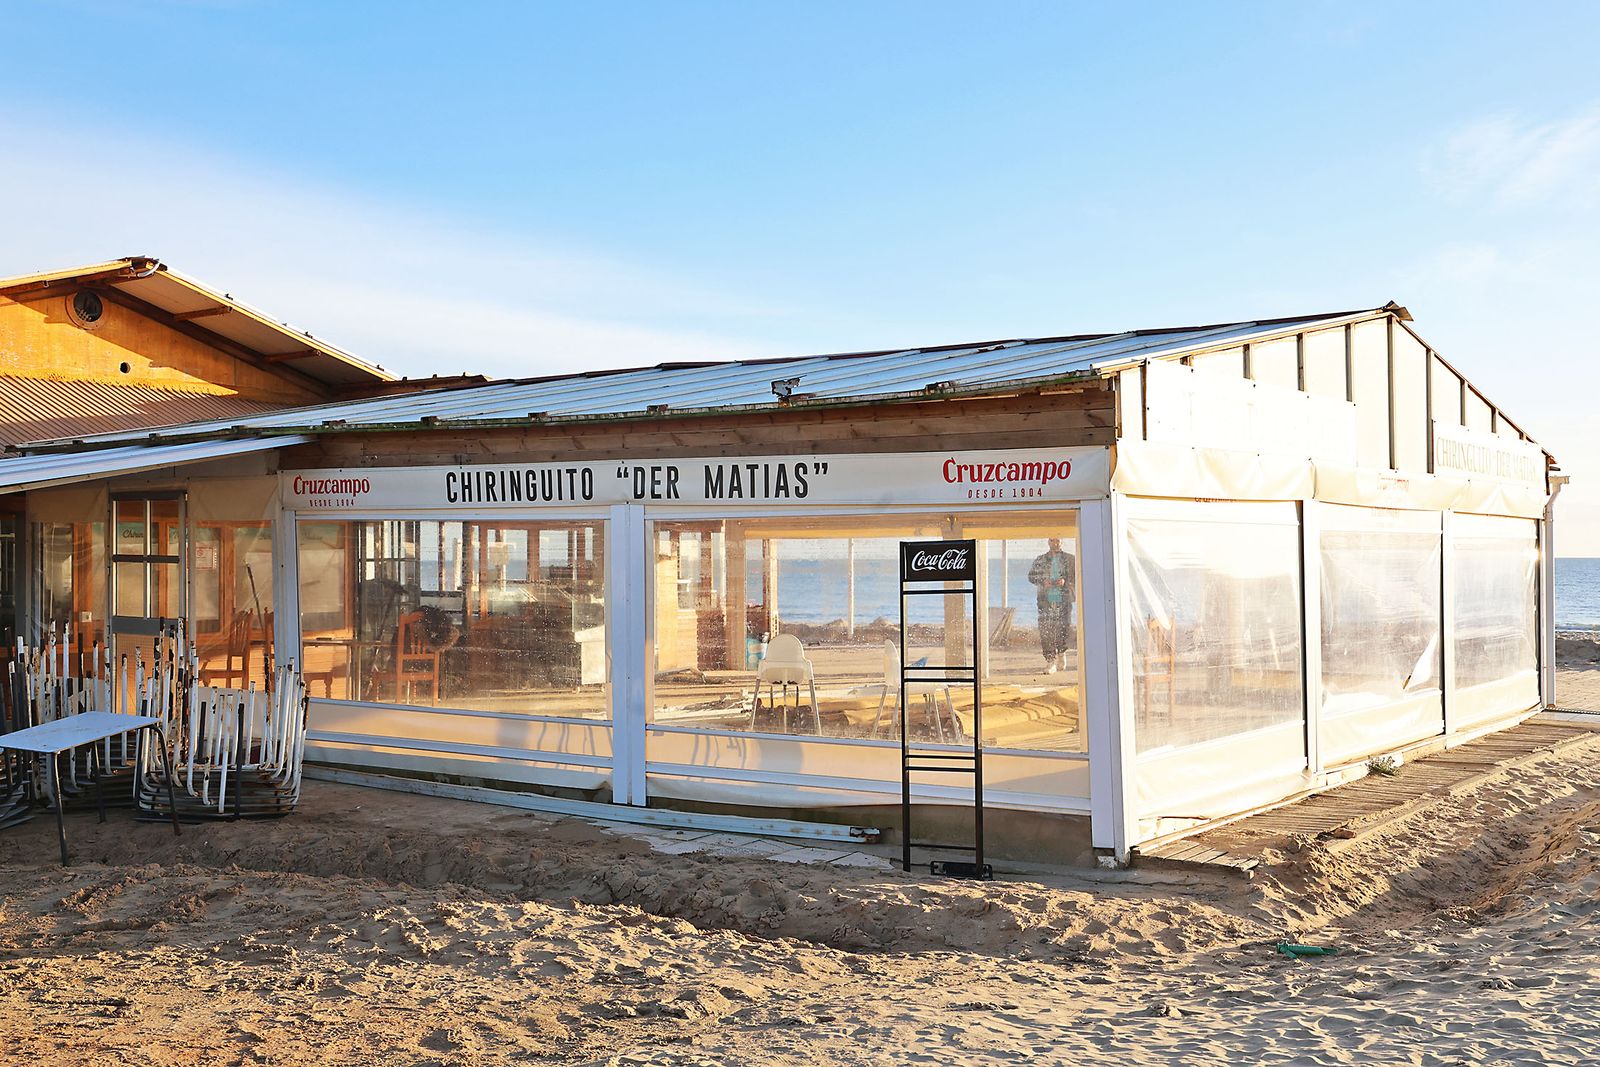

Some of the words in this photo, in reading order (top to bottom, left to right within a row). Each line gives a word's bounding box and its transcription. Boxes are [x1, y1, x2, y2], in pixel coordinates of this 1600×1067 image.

[943, 457, 1072, 484] Cruzcampo
[293, 475, 370, 497] Cruzcampo
[446, 467, 594, 503] CHIRINGUITO
[968, 489, 1003, 499] DESDE
[1012, 487, 1043, 498] 1904
